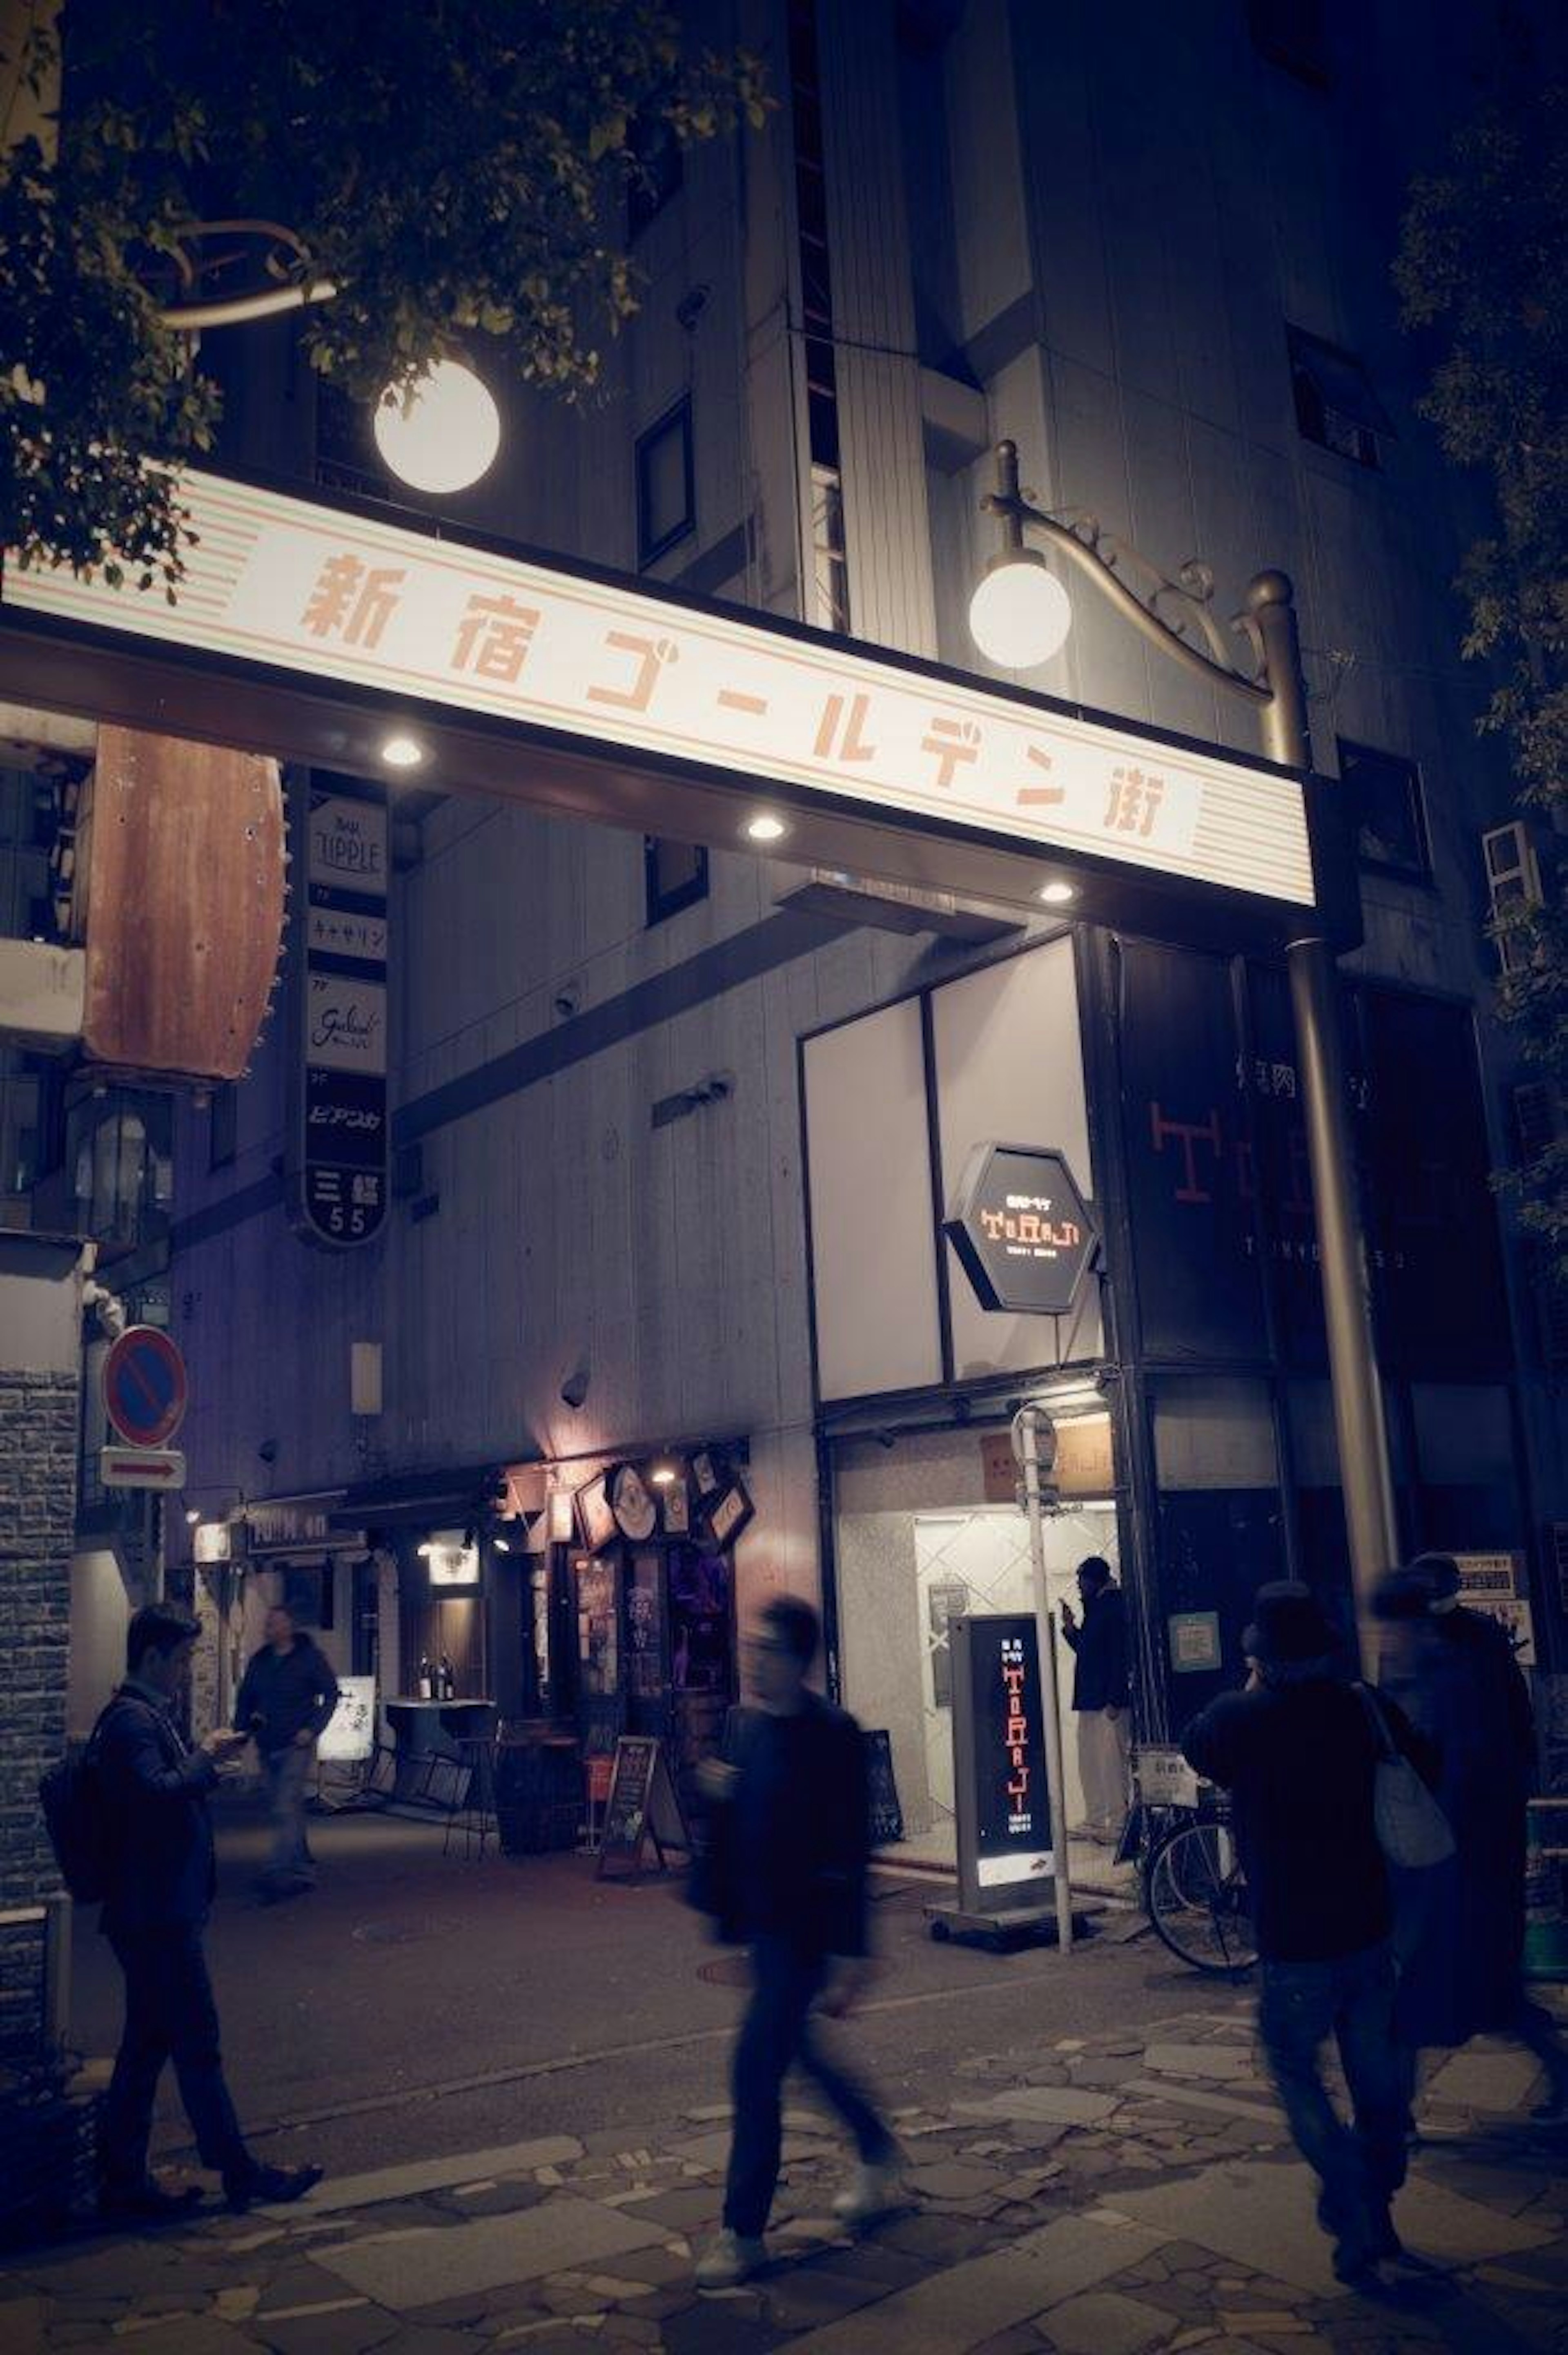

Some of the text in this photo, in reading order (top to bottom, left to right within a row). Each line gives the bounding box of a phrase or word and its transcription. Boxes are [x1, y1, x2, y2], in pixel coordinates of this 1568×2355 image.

[300, 552, 1165, 837] 新宿ゴールデン街
[330, 1206, 365, 1234] 55
[1002, 1665, 1031, 1813] TORAJI
